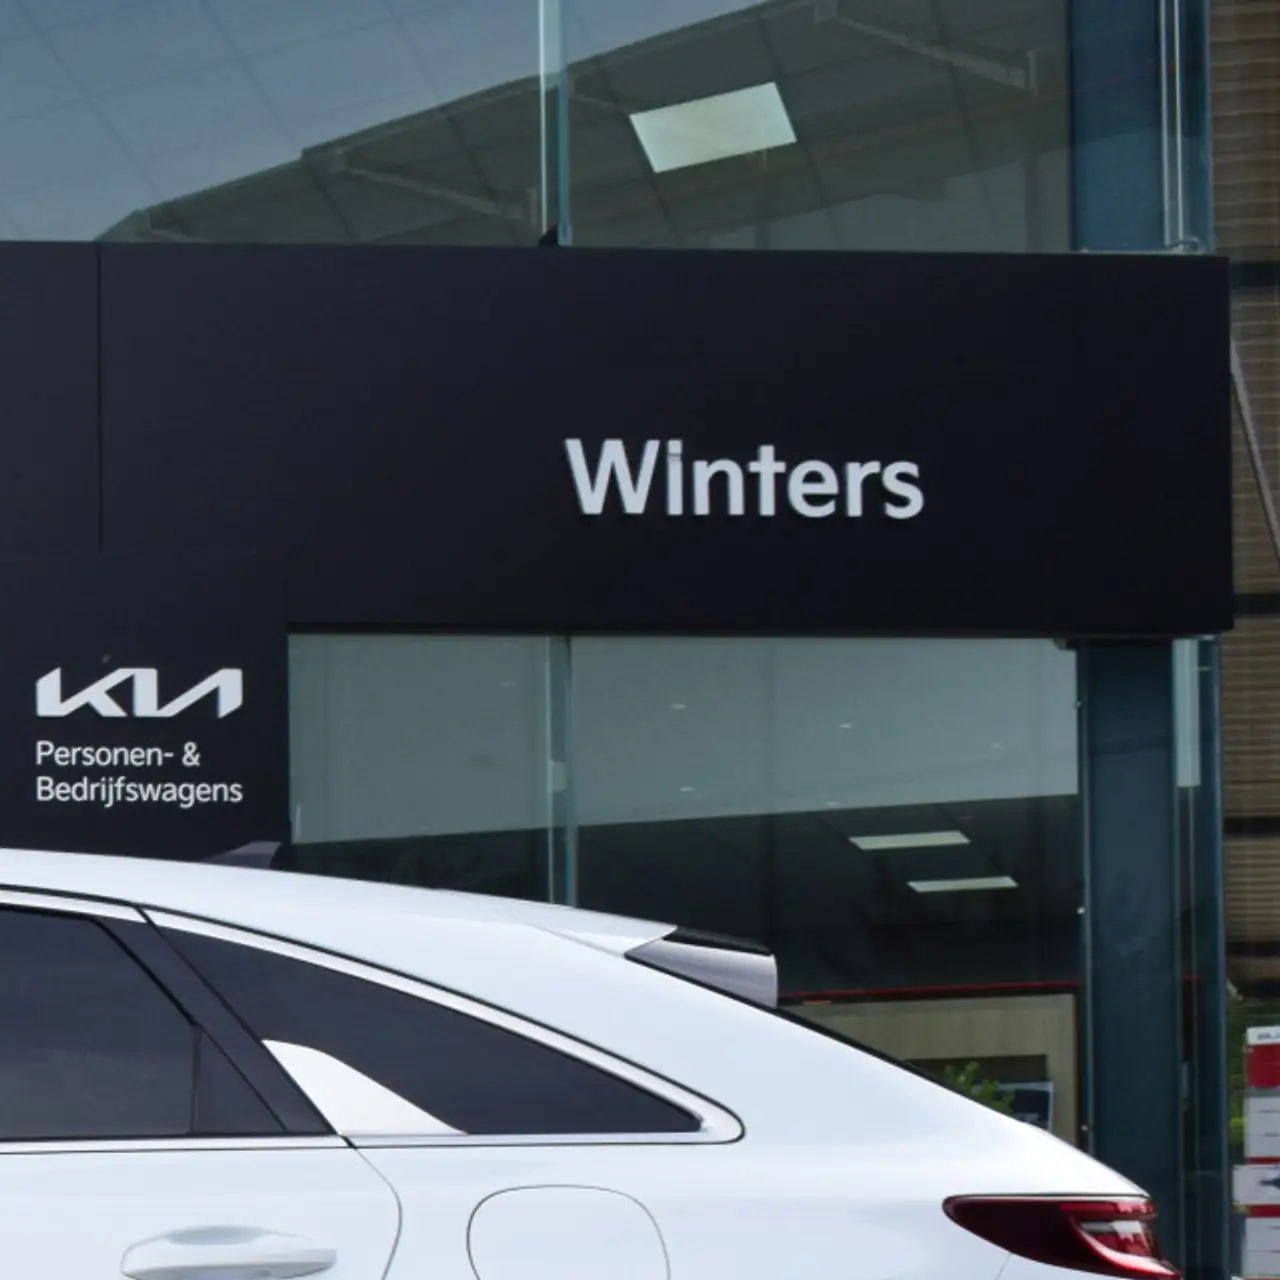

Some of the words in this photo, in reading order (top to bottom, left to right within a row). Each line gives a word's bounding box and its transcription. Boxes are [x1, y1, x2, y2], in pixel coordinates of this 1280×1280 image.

[565, 438, 924, 519] Winters
[36, 666, 243, 718] KIA
[36, 740, 174, 767] Personen-
[181, 741, 201, 767] &
[36, 775, 244, 809] Bedrijfswagens
